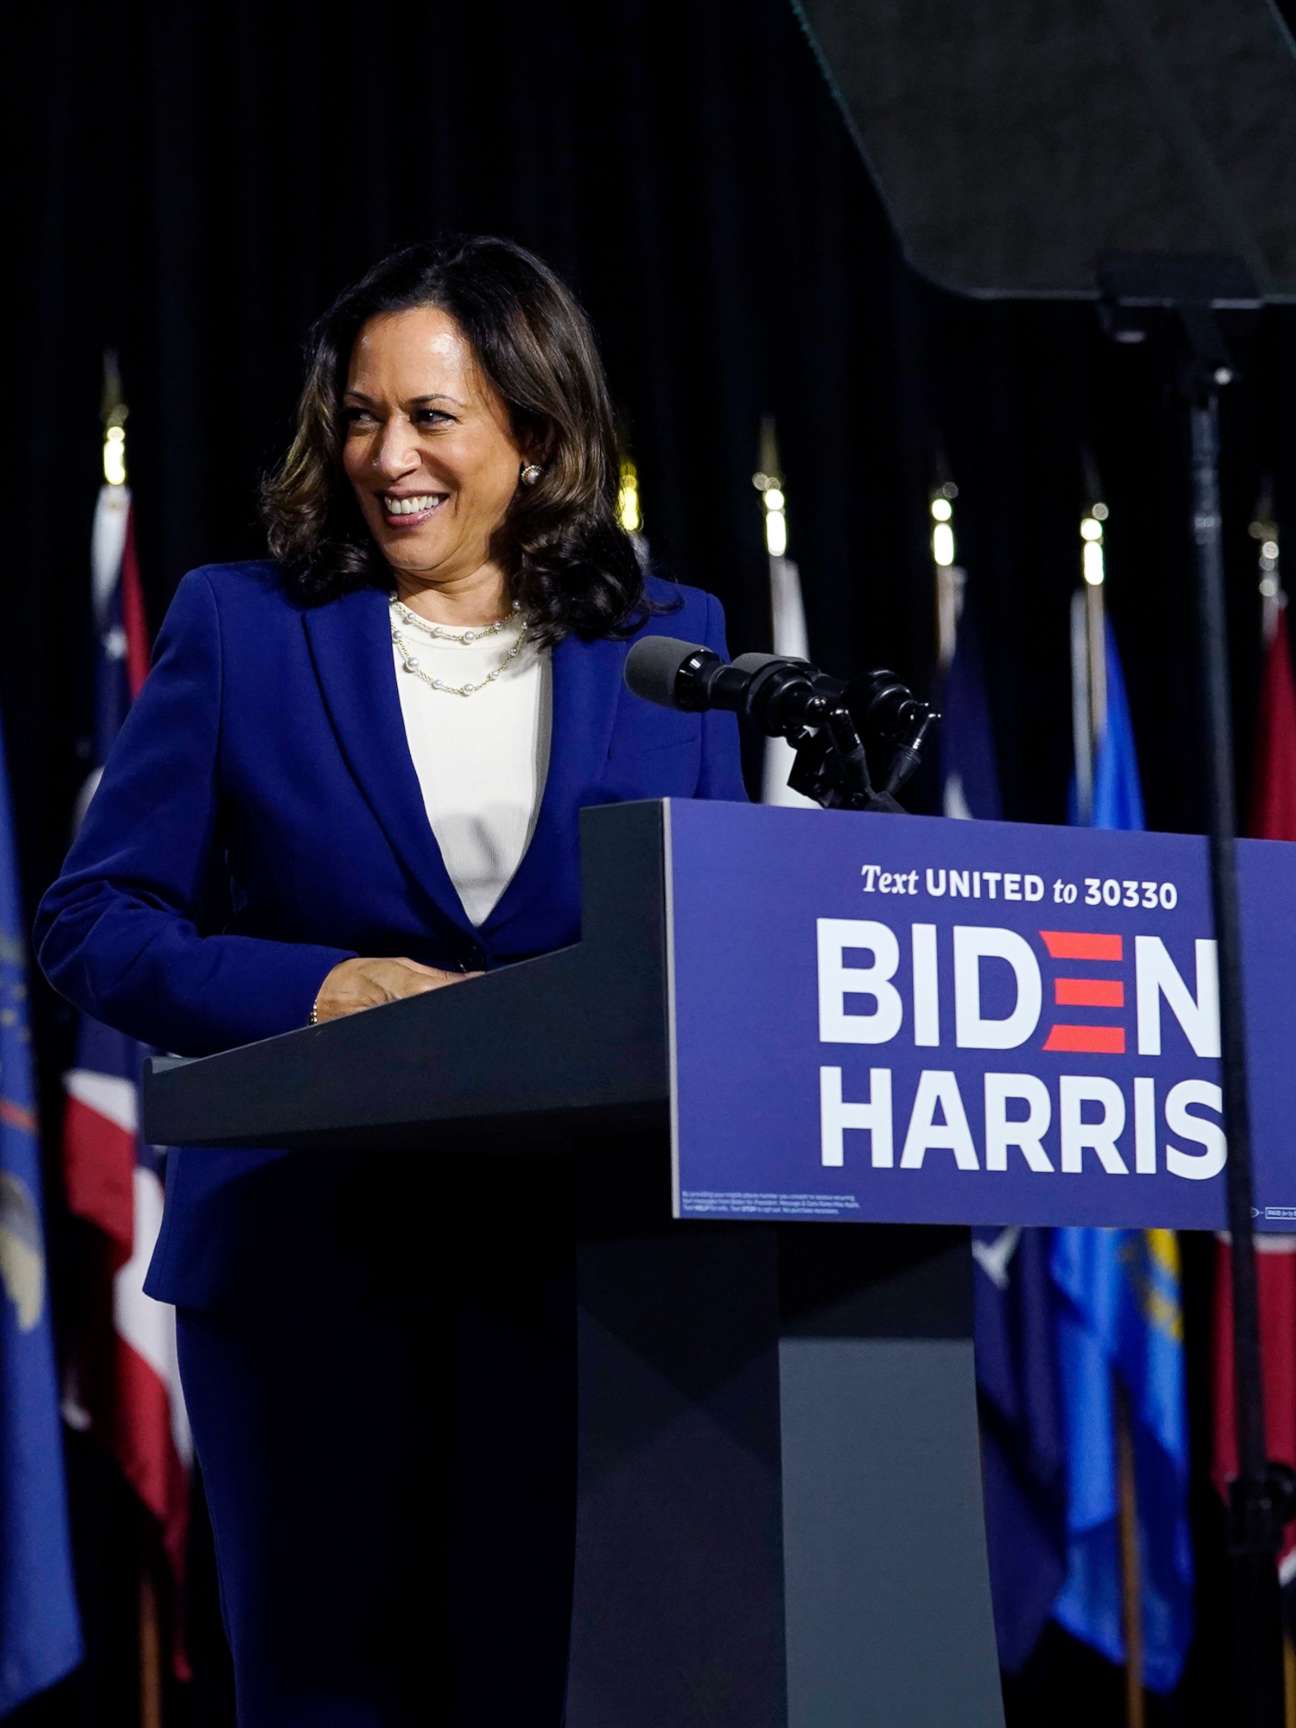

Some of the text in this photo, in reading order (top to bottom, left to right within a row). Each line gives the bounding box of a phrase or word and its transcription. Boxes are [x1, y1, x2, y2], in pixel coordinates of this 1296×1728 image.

[860, 864, 1178, 910] Text UNITED to 30330
[816, 917, 1223, 1058] BIDEN
[819, 1065, 1228, 1181] HARRIS
